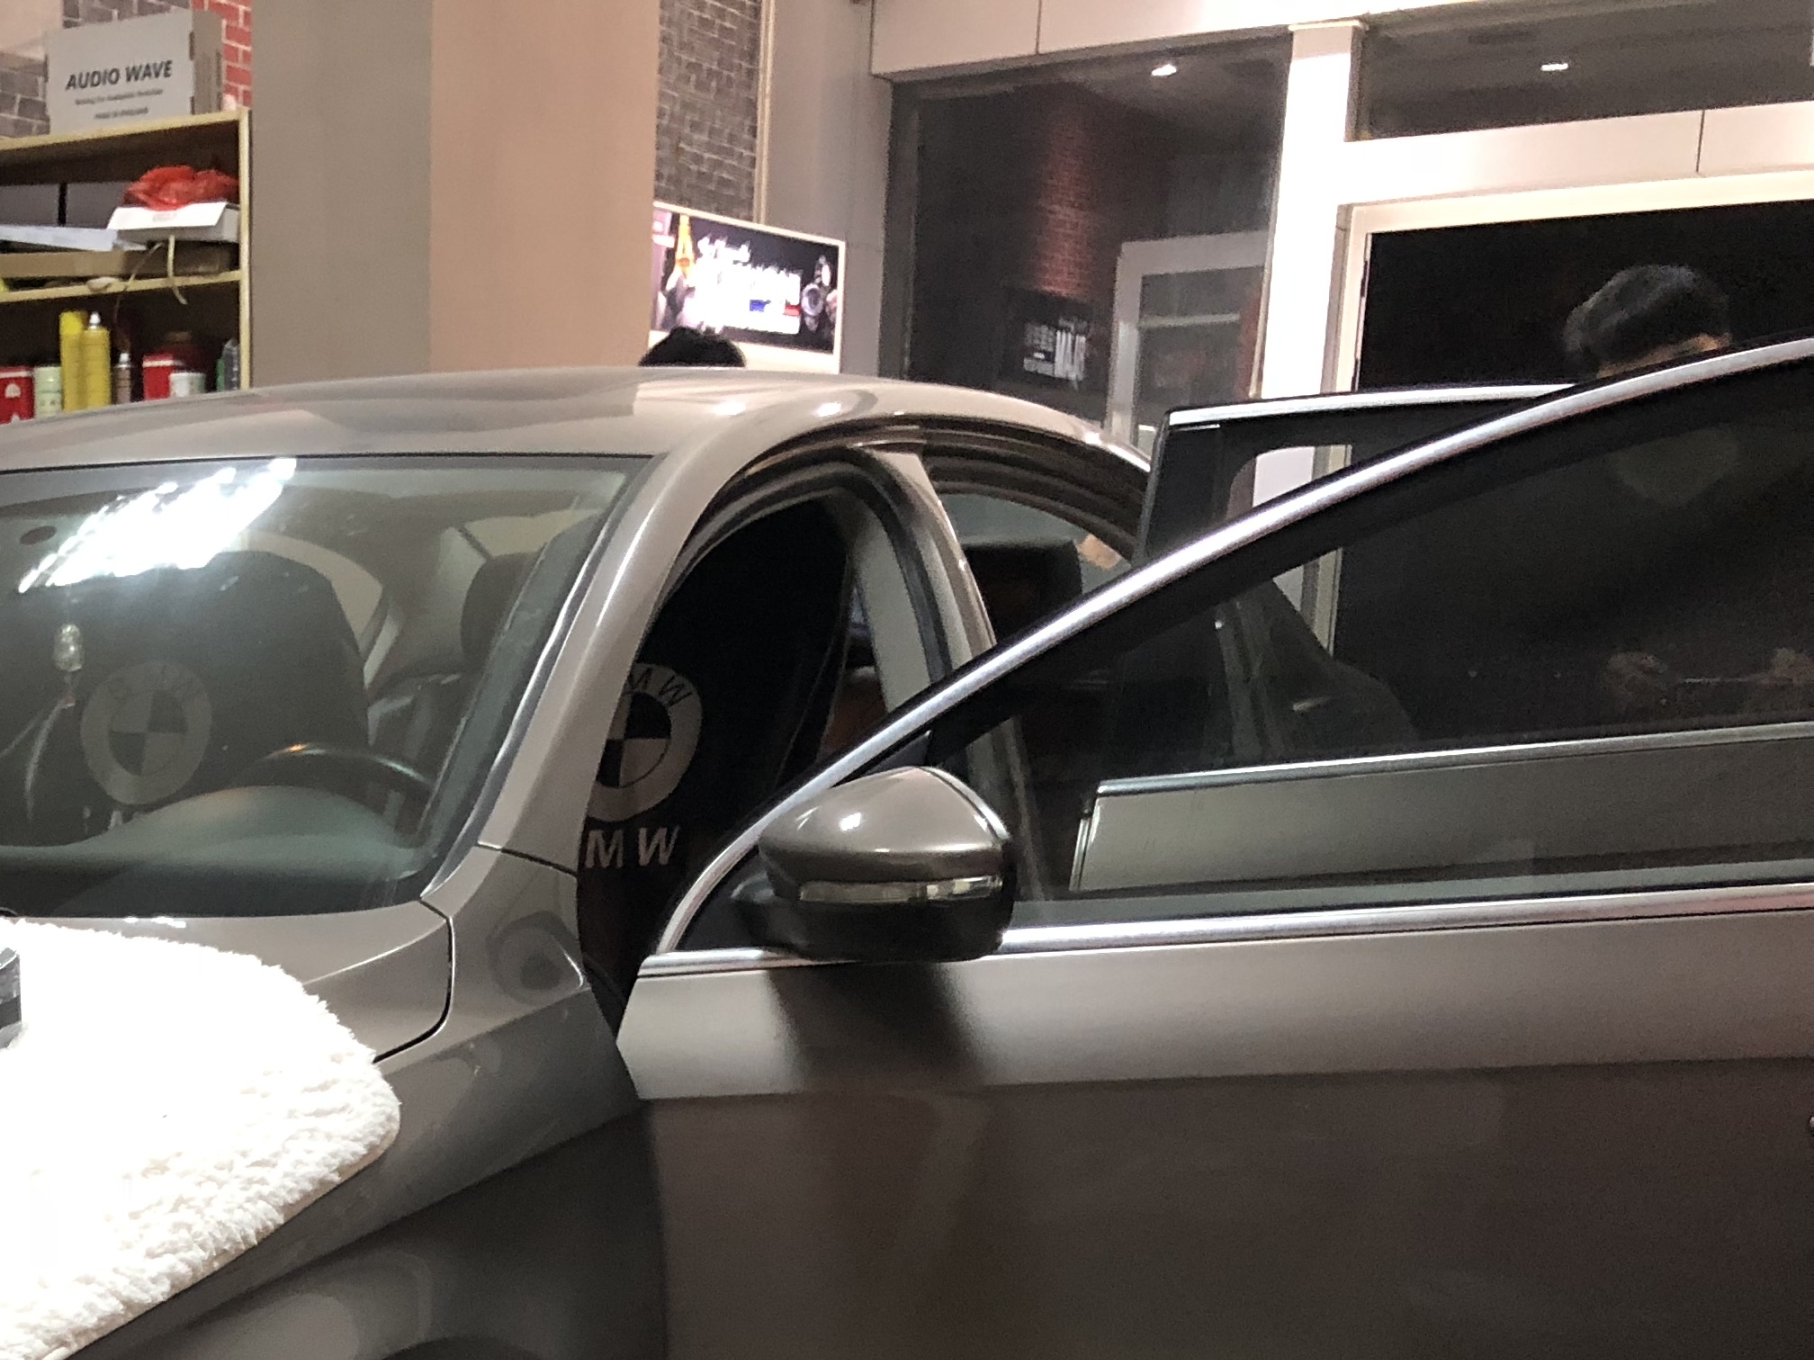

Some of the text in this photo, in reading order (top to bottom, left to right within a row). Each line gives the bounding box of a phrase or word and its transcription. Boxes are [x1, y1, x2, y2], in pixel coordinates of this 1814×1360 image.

[65, 59, 173, 91] AUDIO WAVE
[585, 826, 680, 869] MW
